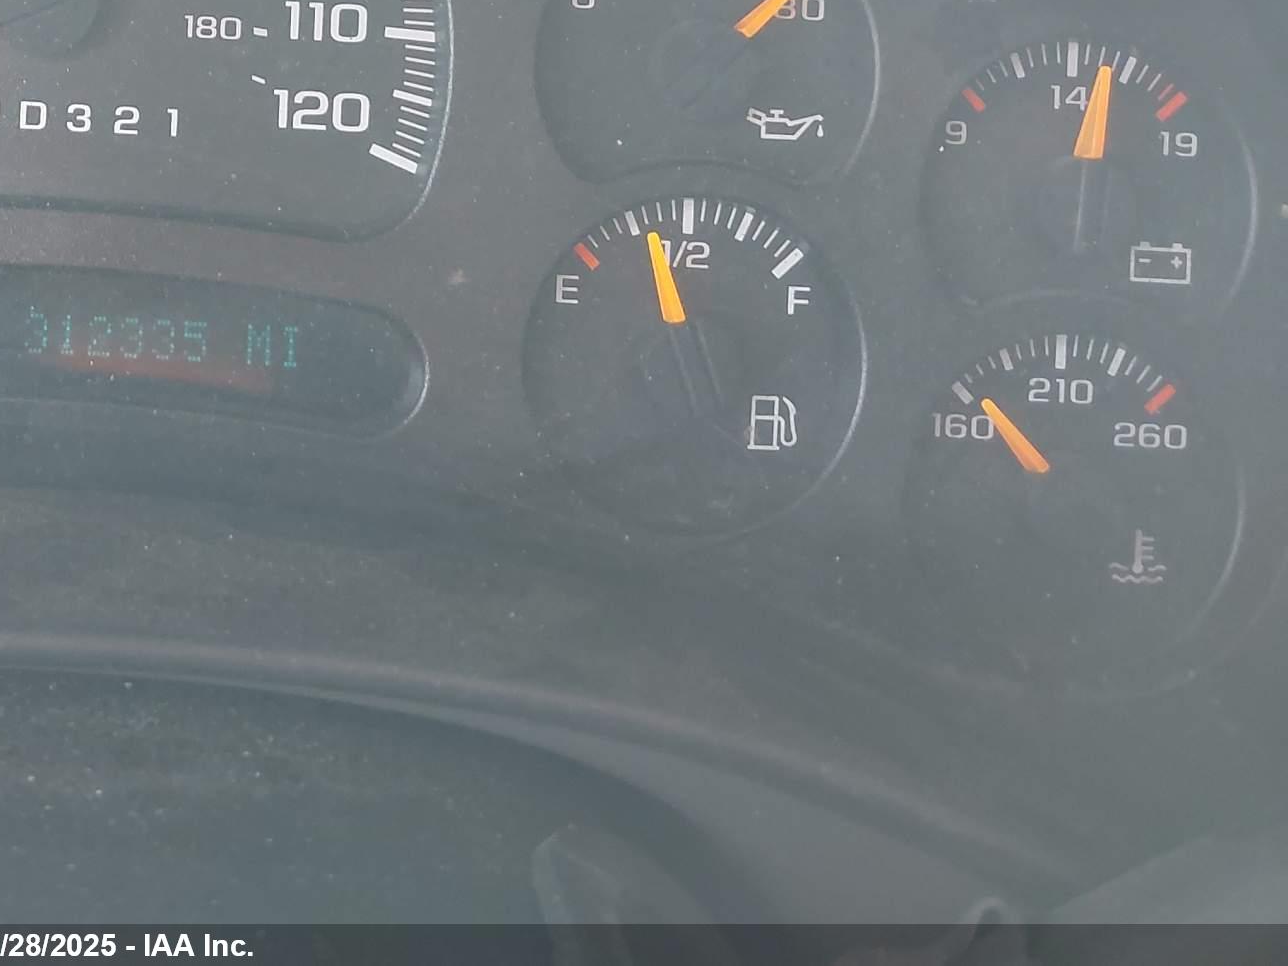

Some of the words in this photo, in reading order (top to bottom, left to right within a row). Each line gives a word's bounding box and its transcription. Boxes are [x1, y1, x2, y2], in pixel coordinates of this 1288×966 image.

[184, 14, 242, 40] 180
[285, 1, 368, 42] 110
[273, 89, 370, 133] 120
[1050, 85, 1088, 111] 14
[19, 101, 47, 130] D
[66, 104, 91, 133] 3
[113, 106, 140, 135] 2
[167, 108, 178, 137] 1
[945, 120, 968, 146] 9
[1158, 131, 1197, 158] 19
[661, 240, 710, 269] 1/2
[556, 274, 579, 304] E
[787, 285, 811, 315] F
[25, 313, 207, 362] 312335
[246, 323, 299, 368] MI
[1027, 376, 1093, 404] 210
[933, 412, 995, 441] 160
[1112, 422, 1188, 450] 260
